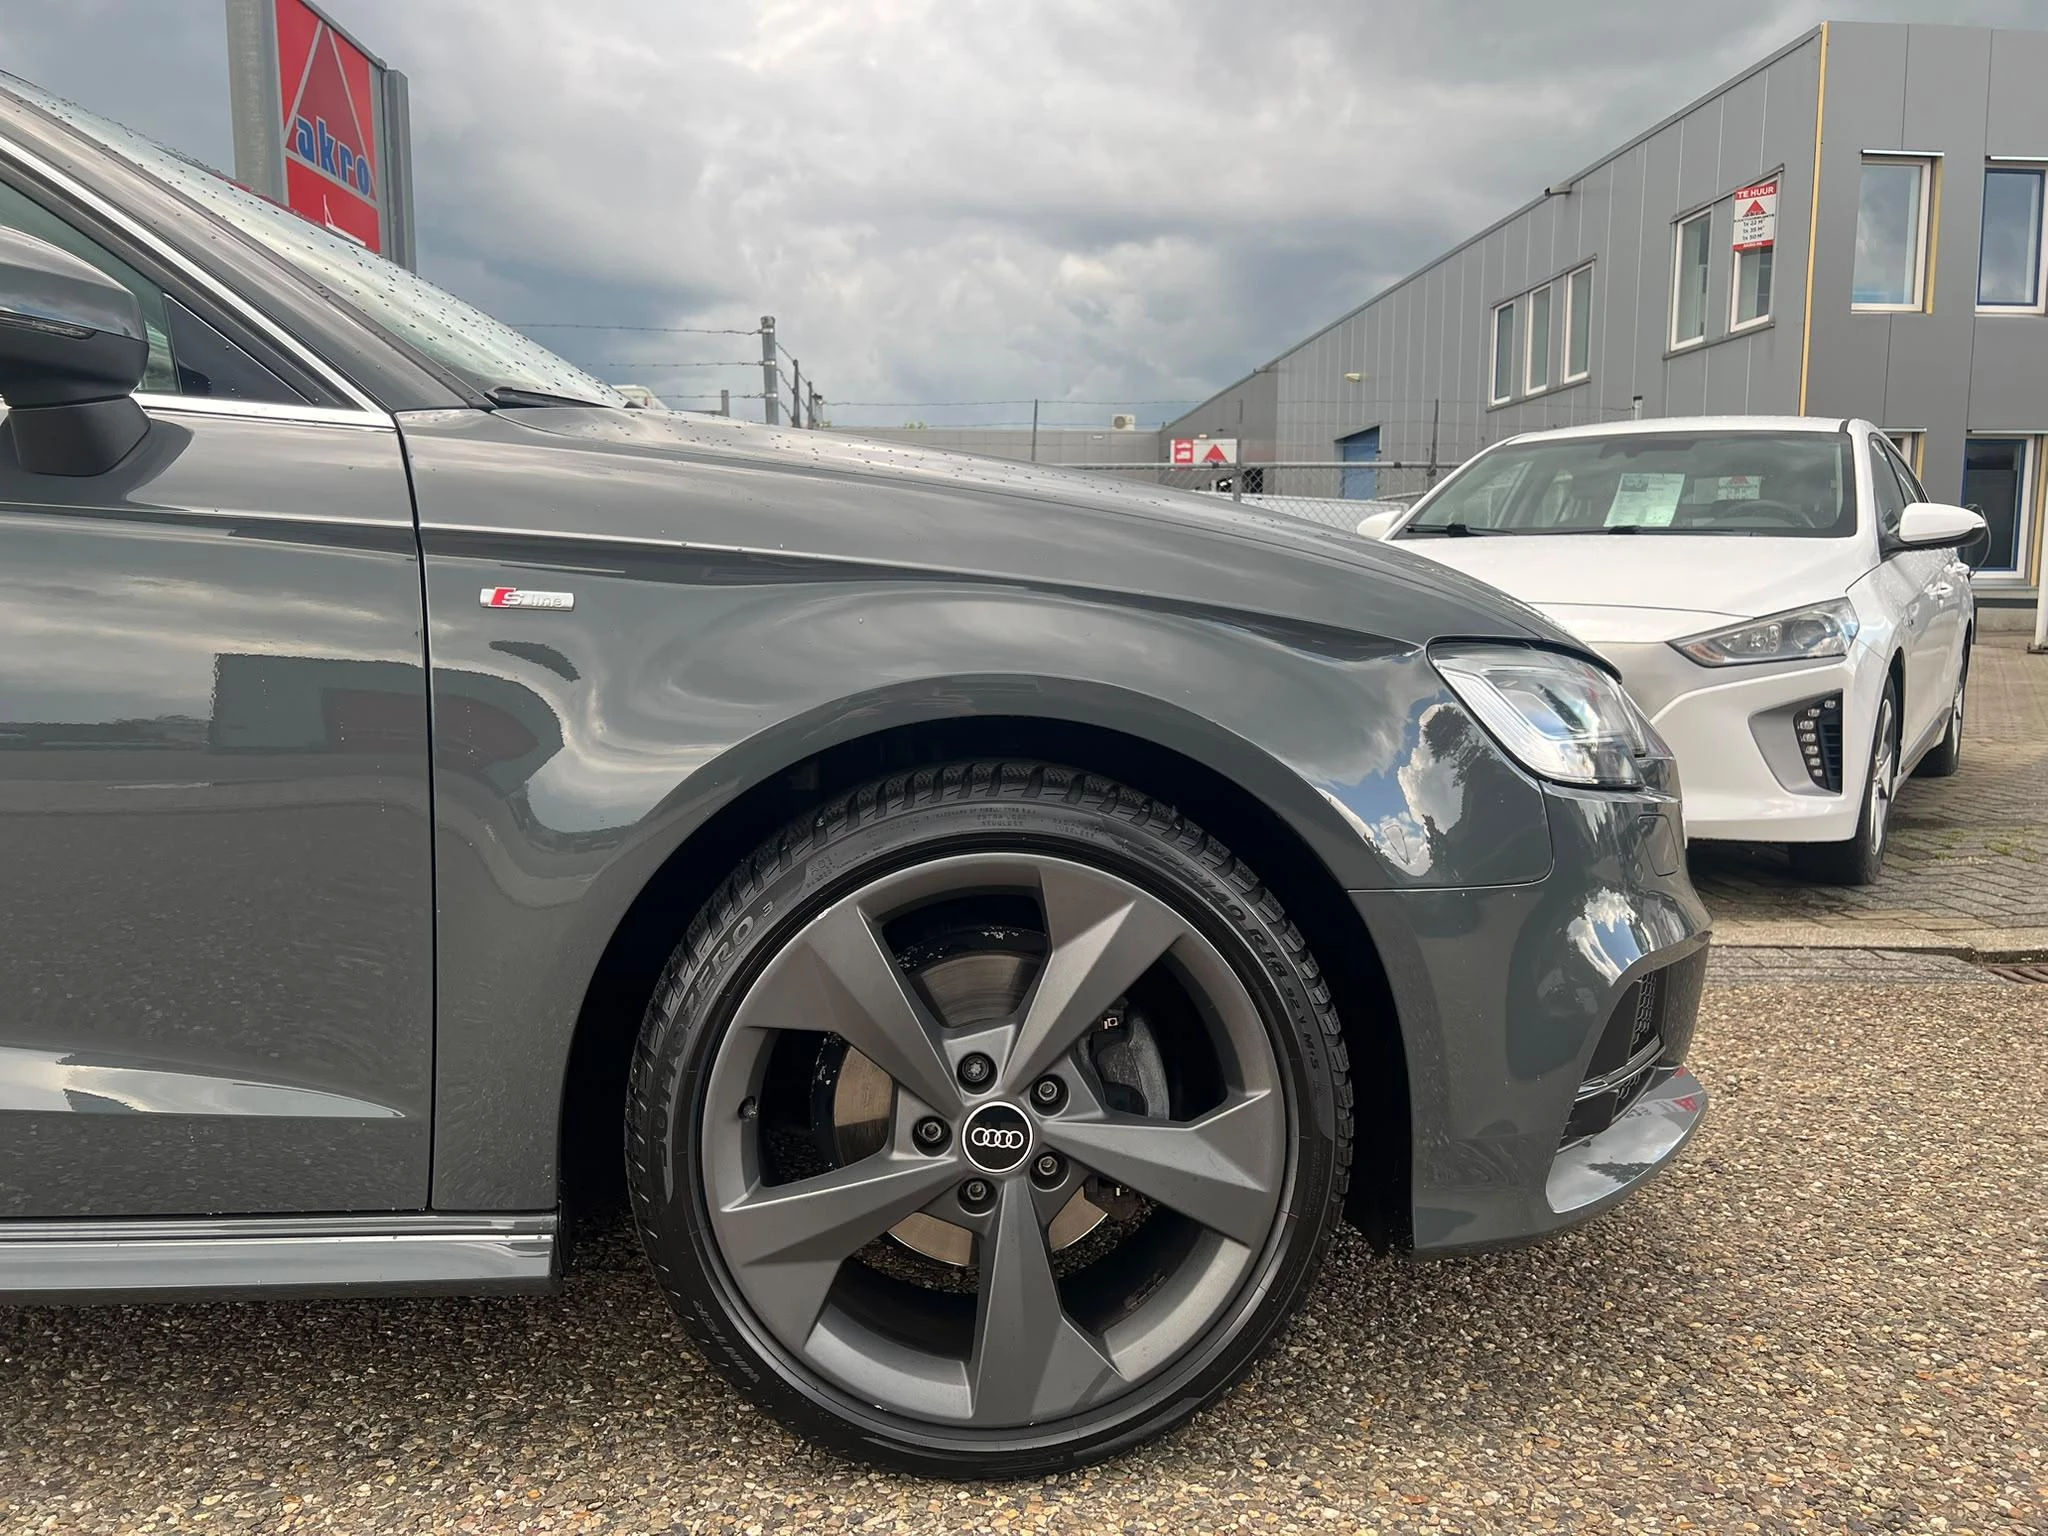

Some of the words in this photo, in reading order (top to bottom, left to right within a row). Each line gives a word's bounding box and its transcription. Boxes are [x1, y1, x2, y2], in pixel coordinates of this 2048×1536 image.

[296, 115, 370, 197] akro
[1737, 191, 1749, 199] TE
[1750, 187, 1774, 197] HUUR
[532, 594, 565, 607] line
[762, 900, 774, 918] 3
